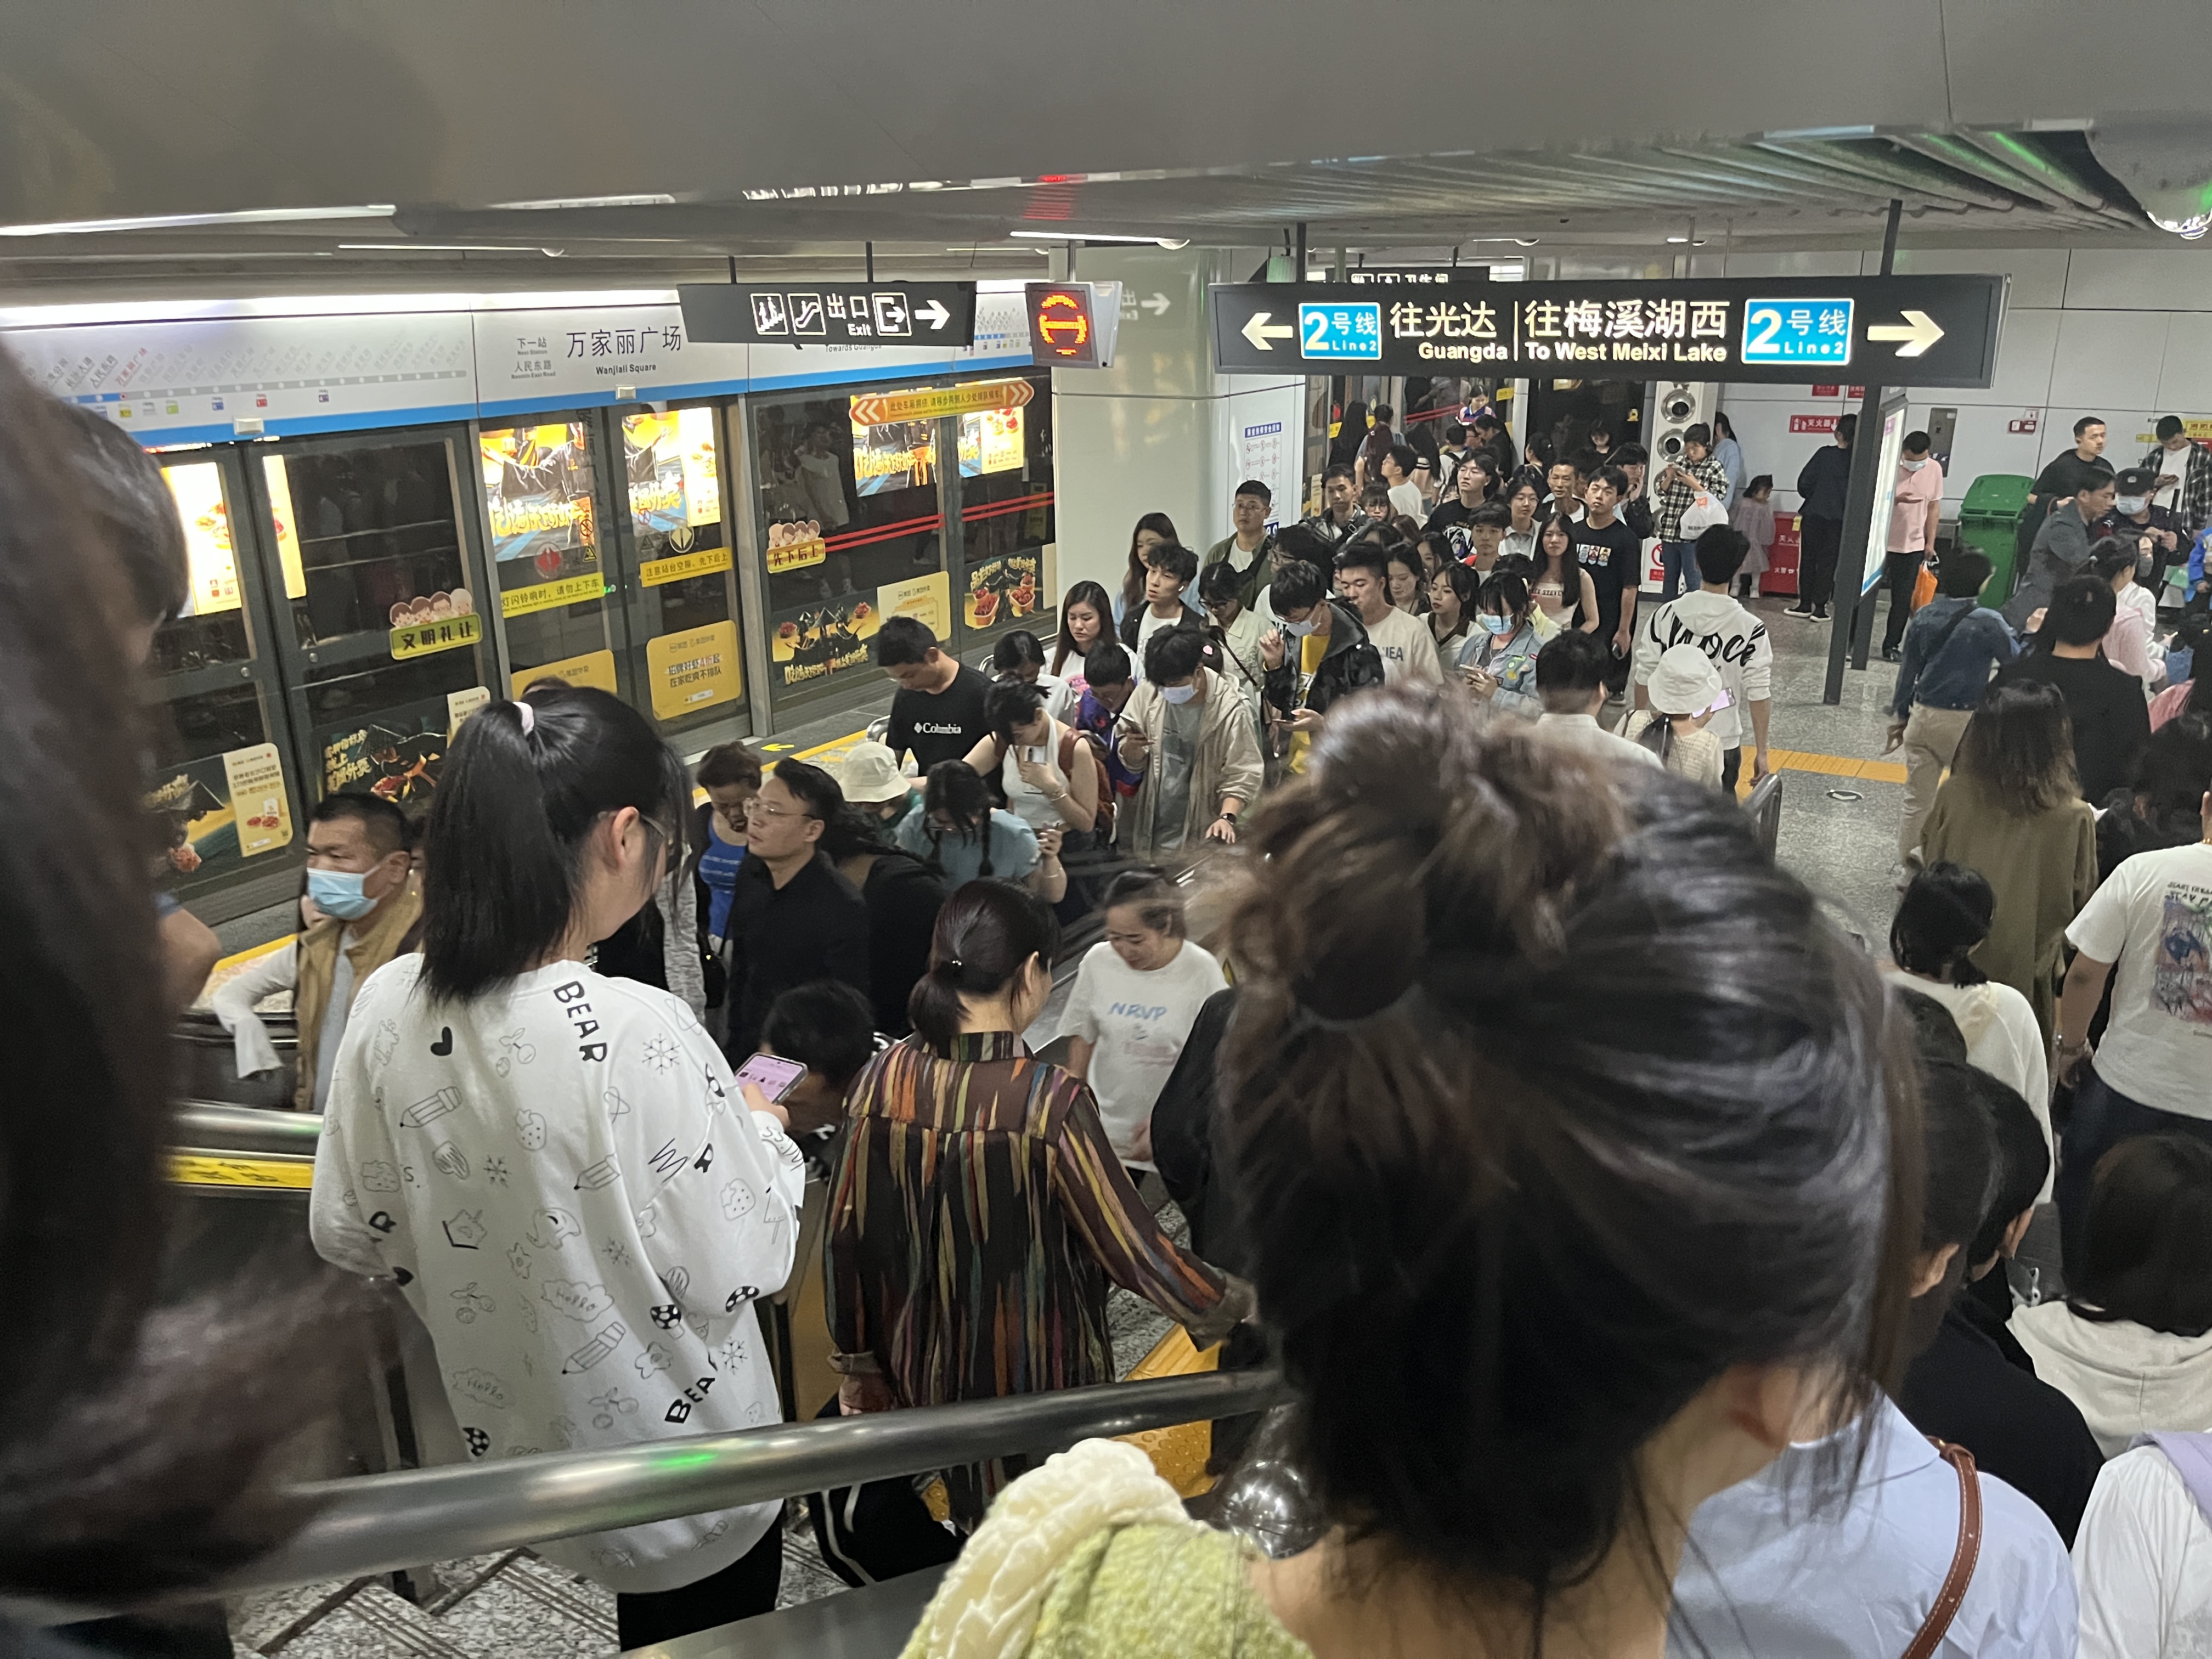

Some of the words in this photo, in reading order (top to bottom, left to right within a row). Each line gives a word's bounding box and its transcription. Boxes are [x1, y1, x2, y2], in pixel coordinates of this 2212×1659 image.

[826, 292, 869, 320] 出口
[1390, 301, 1497, 338] 往光达
[1525, 300, 1730, 338] 往梅溪湖西
[847, 323, 872, 337] Exit
[517, 337, 547, 349] 下一站
[566, 325, 681, 358] 万家丽广场
[1419, 342, 1508, 362] Guangda
[1525, 342, 1550, 360] To
[1555, 342, 1607, 362] West
[1612, 342, 1668, 362] Meixi
[1674, 343, 1728, 362] Lake
[515, 360, 551, 373] 人民东路
[629, 363, 657, 374] Square
[774, 546, 819, 567] 先下后上
[401, 621, 475, 650] 文明礼让
[922, 722, 962, 735] Columbia
[553, 980, 608, 1063] BEAR
[664, 1362, 716, 1425] BEA
